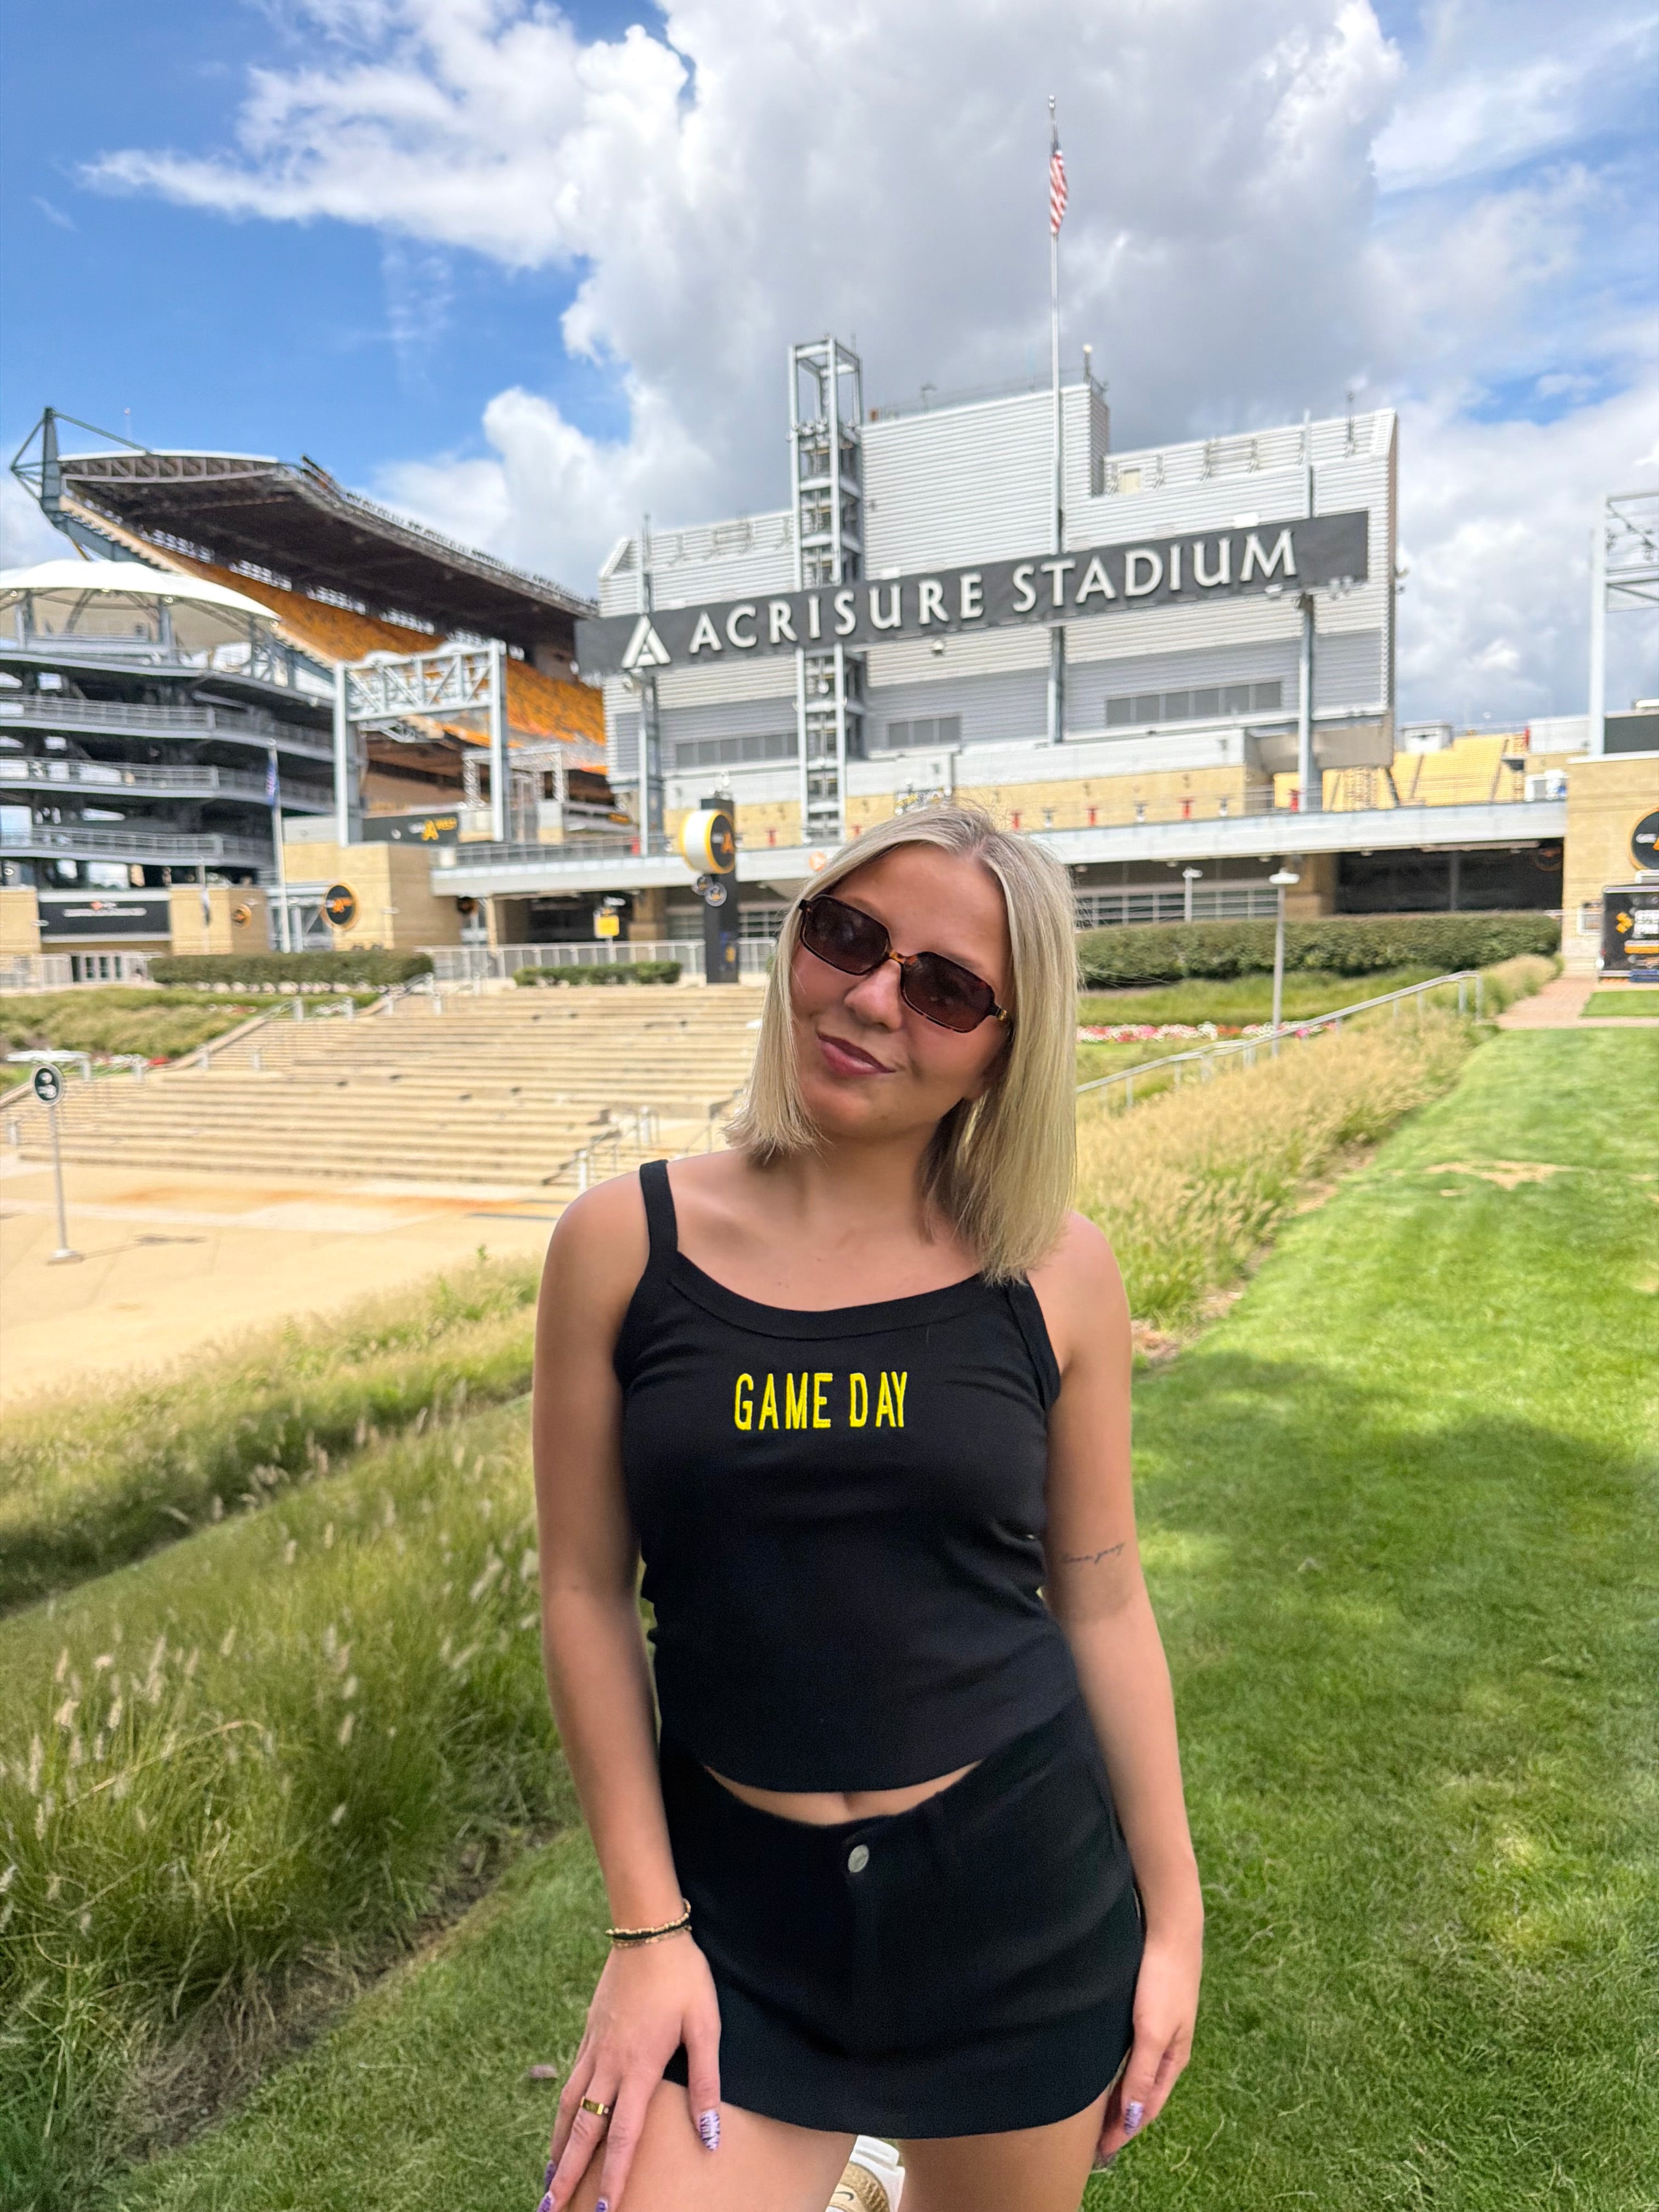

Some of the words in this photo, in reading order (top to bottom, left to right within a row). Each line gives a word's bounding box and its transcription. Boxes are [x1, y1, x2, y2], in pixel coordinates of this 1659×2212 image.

[689, 572, 984, 654] ACRISURE
[1012, 528, 1296, 613] STADIUM
[735, 1372, 833, 1430] GAME
[850, 1372, 907, 1427] DAY
